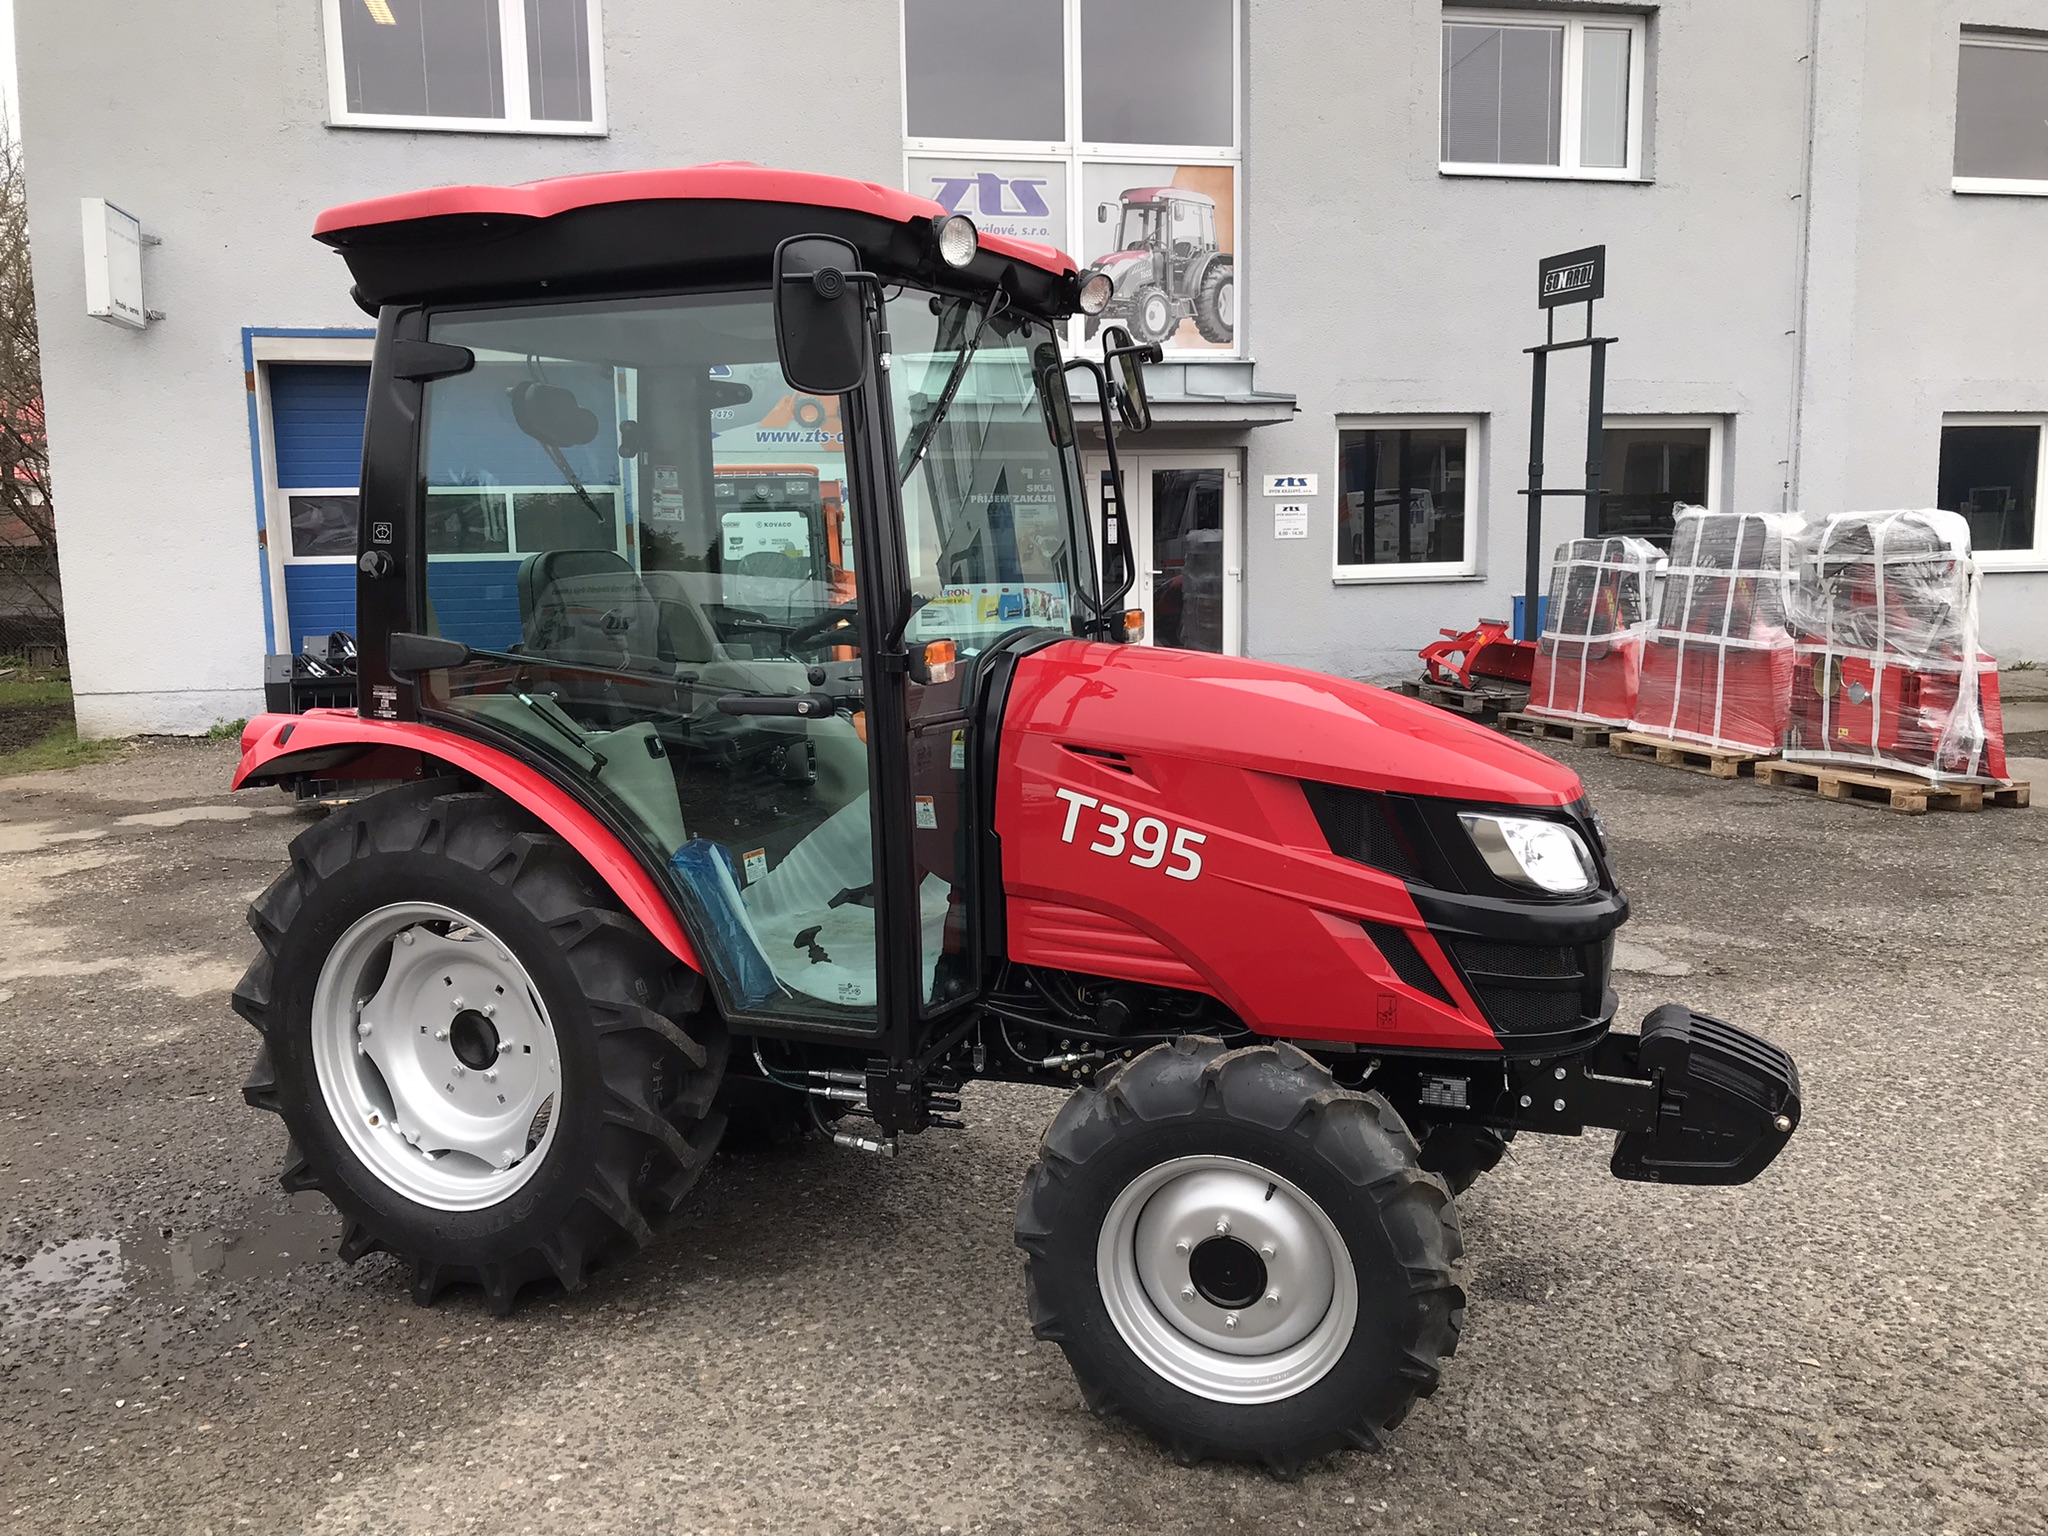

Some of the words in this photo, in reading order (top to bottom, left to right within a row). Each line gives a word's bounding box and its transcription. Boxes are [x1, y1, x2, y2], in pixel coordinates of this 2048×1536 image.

[931, 172, 1050, 217] zts
[977, 223, 1017, 236] rálové,
[1021, 226, 1050, 236] s.r.o.
[1274, 477, 1308, 487] zts
[1026, 484, 1054, 493] SKLA
[1013, 493, 1056, 503] ZAKÁZE
[1055, 787, 1208, 882] T395
